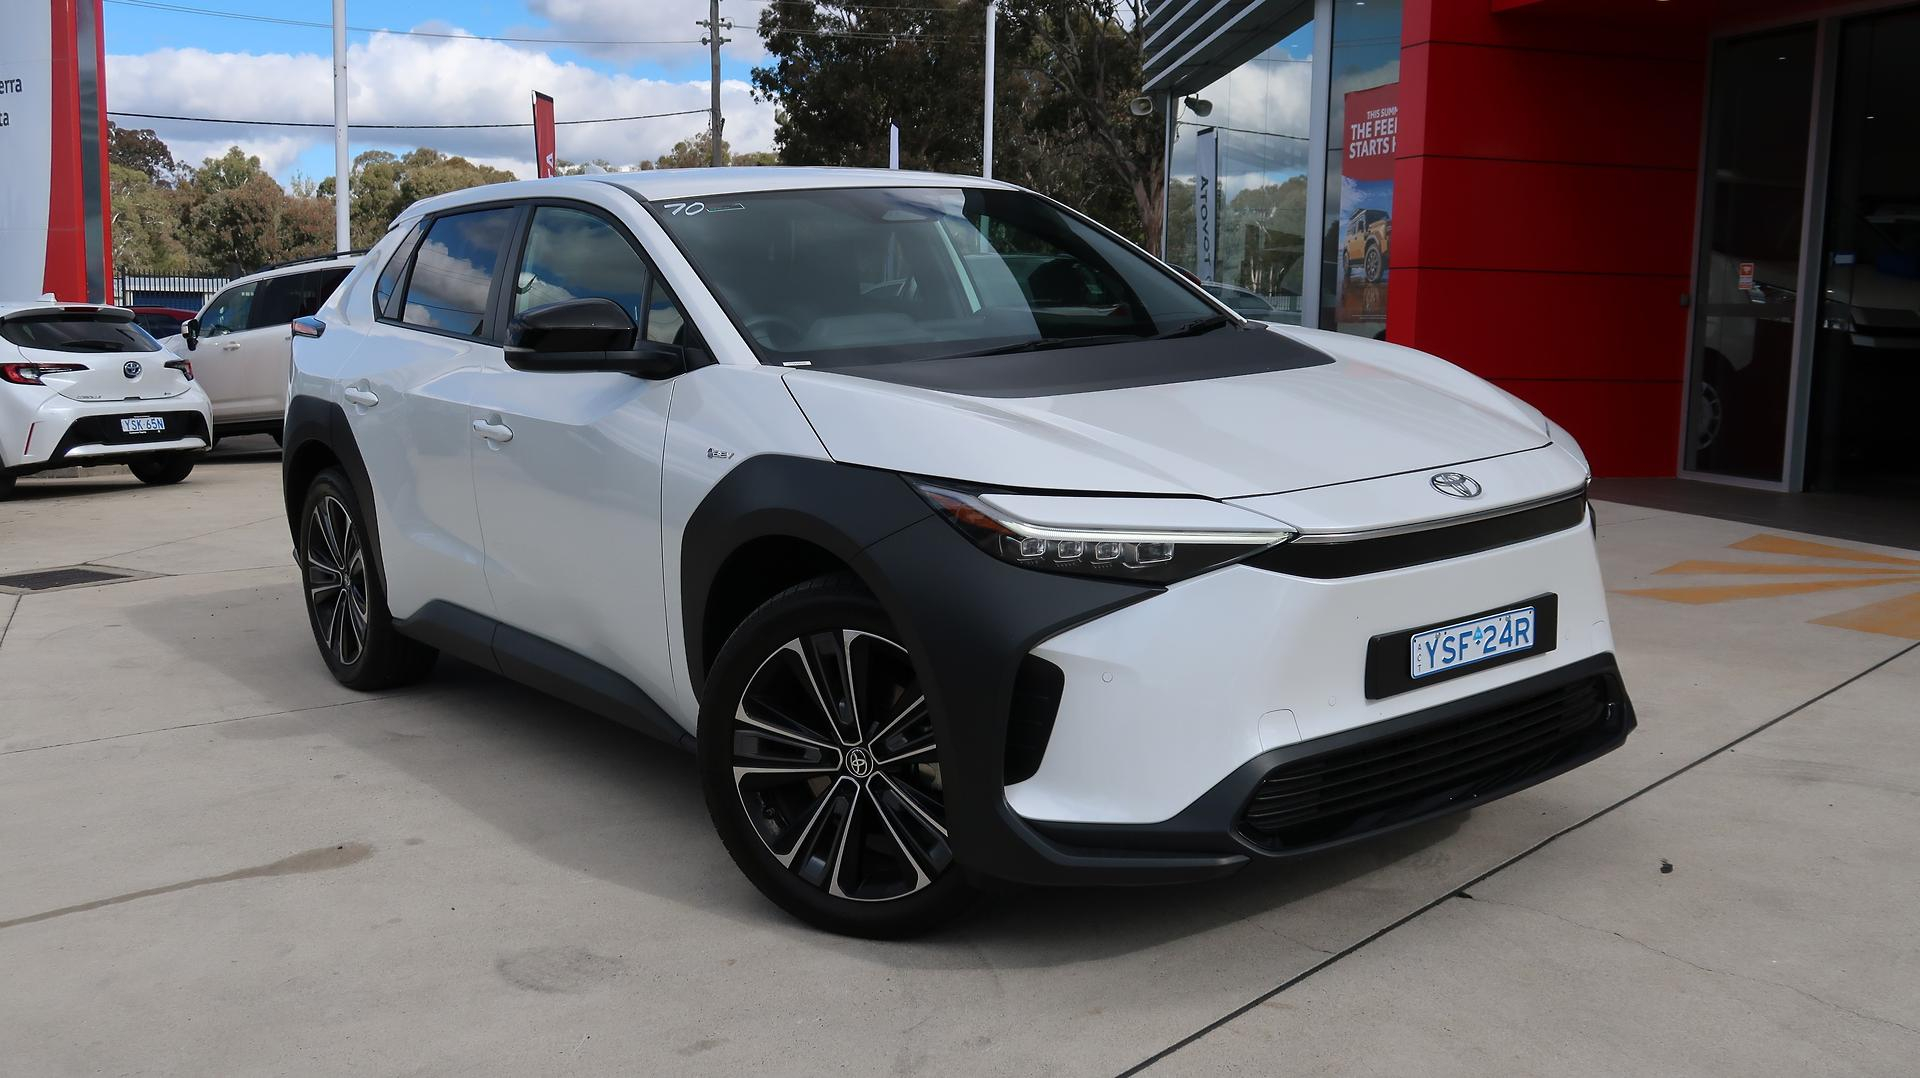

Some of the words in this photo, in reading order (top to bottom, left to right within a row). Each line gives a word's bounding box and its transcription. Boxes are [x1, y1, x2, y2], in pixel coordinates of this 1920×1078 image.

[1367, 110, 1380, 119] THIS
[1351, 122, 1372, 140] THE
[1349, 137, 1389, 159] STARTS
[663, 202, 705, 216] 70
[126, 420, 144, 430] YSK
[147, 419, 164, 429] 65N
[1425, 631, 1473, 668] YSF
[1482, 617, 1530, 653] 24R
